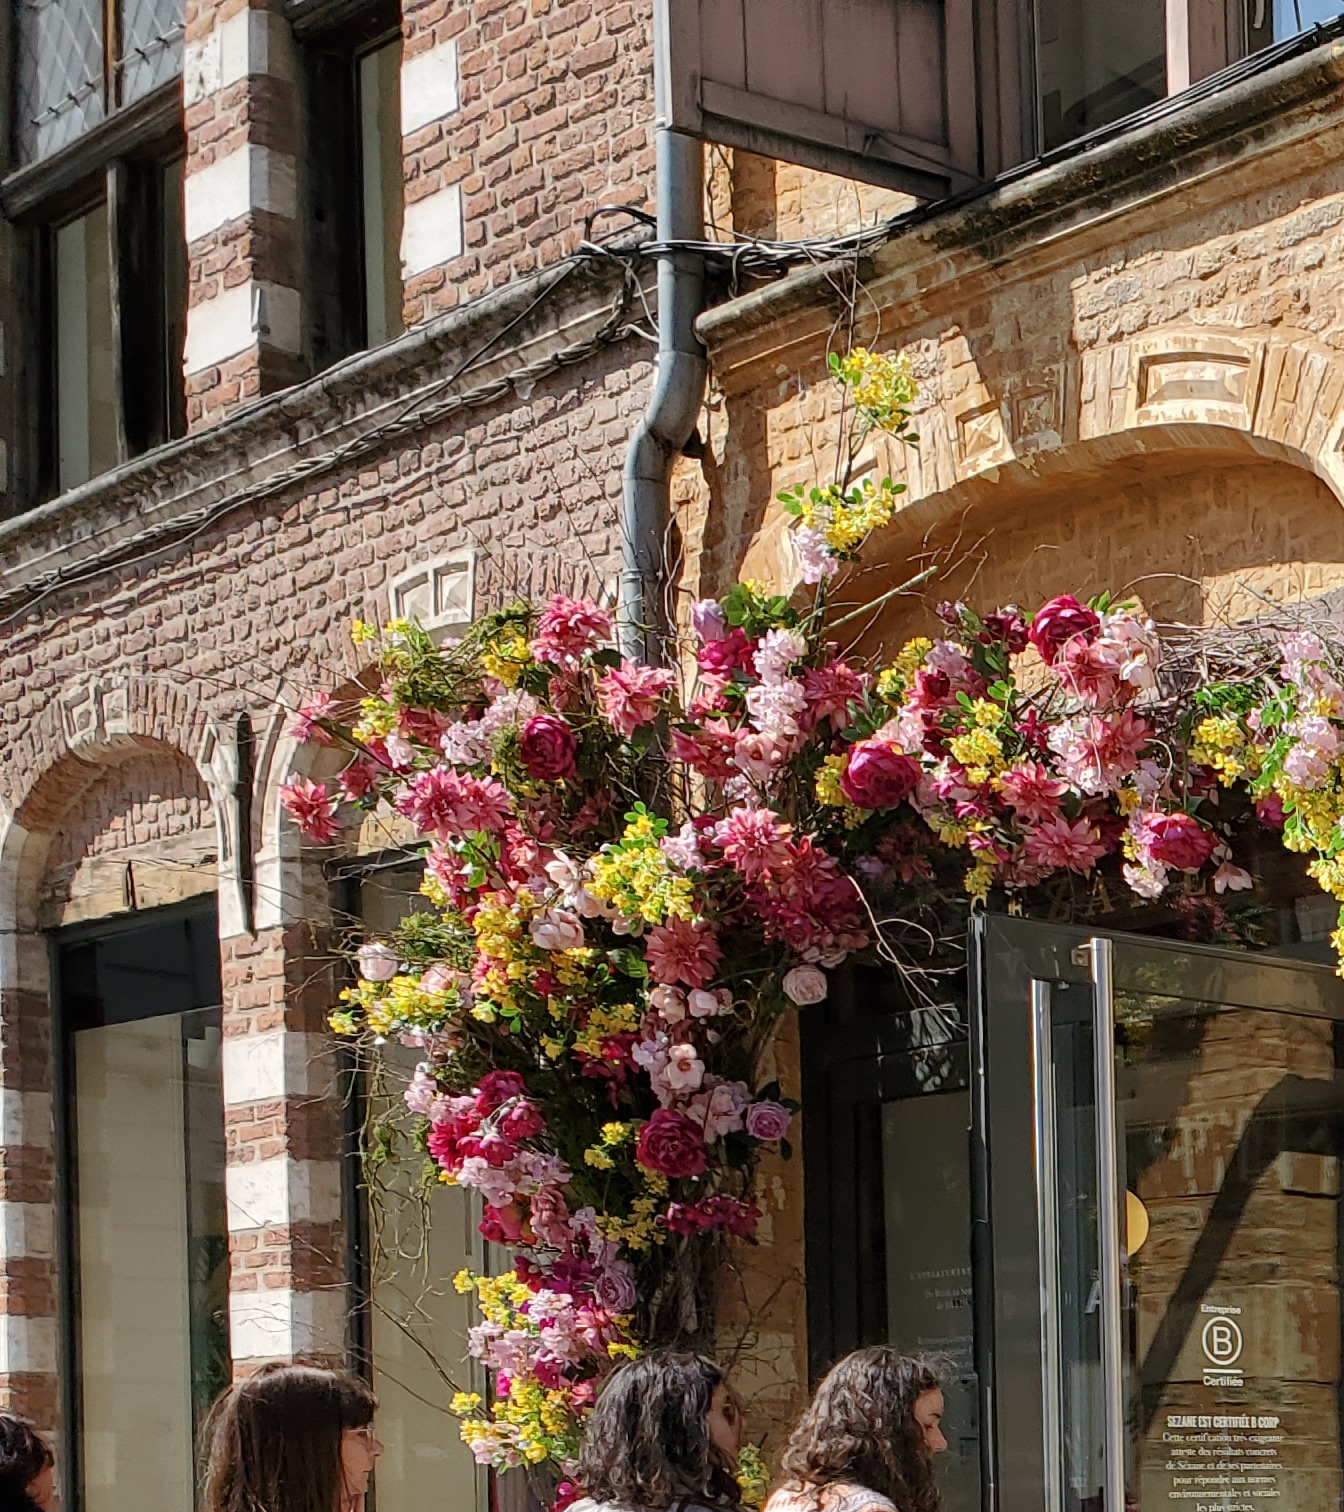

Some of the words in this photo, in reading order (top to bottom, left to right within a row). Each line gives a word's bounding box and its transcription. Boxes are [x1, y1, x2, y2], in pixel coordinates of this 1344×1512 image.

[1201, 1304, 1242, 1315] Entreprise
[1213, 1326, 1233, 1355] B
[1203, 1376, 1244, 1387] Certifiée
[1199, 1416, 1212, 1428] EST
[1213, 1413, 1250, 1428] CERTIFIÉE
[1251, 1416, 1257, 1428] B
[1258, 1416, 1280, 1428] CORP
